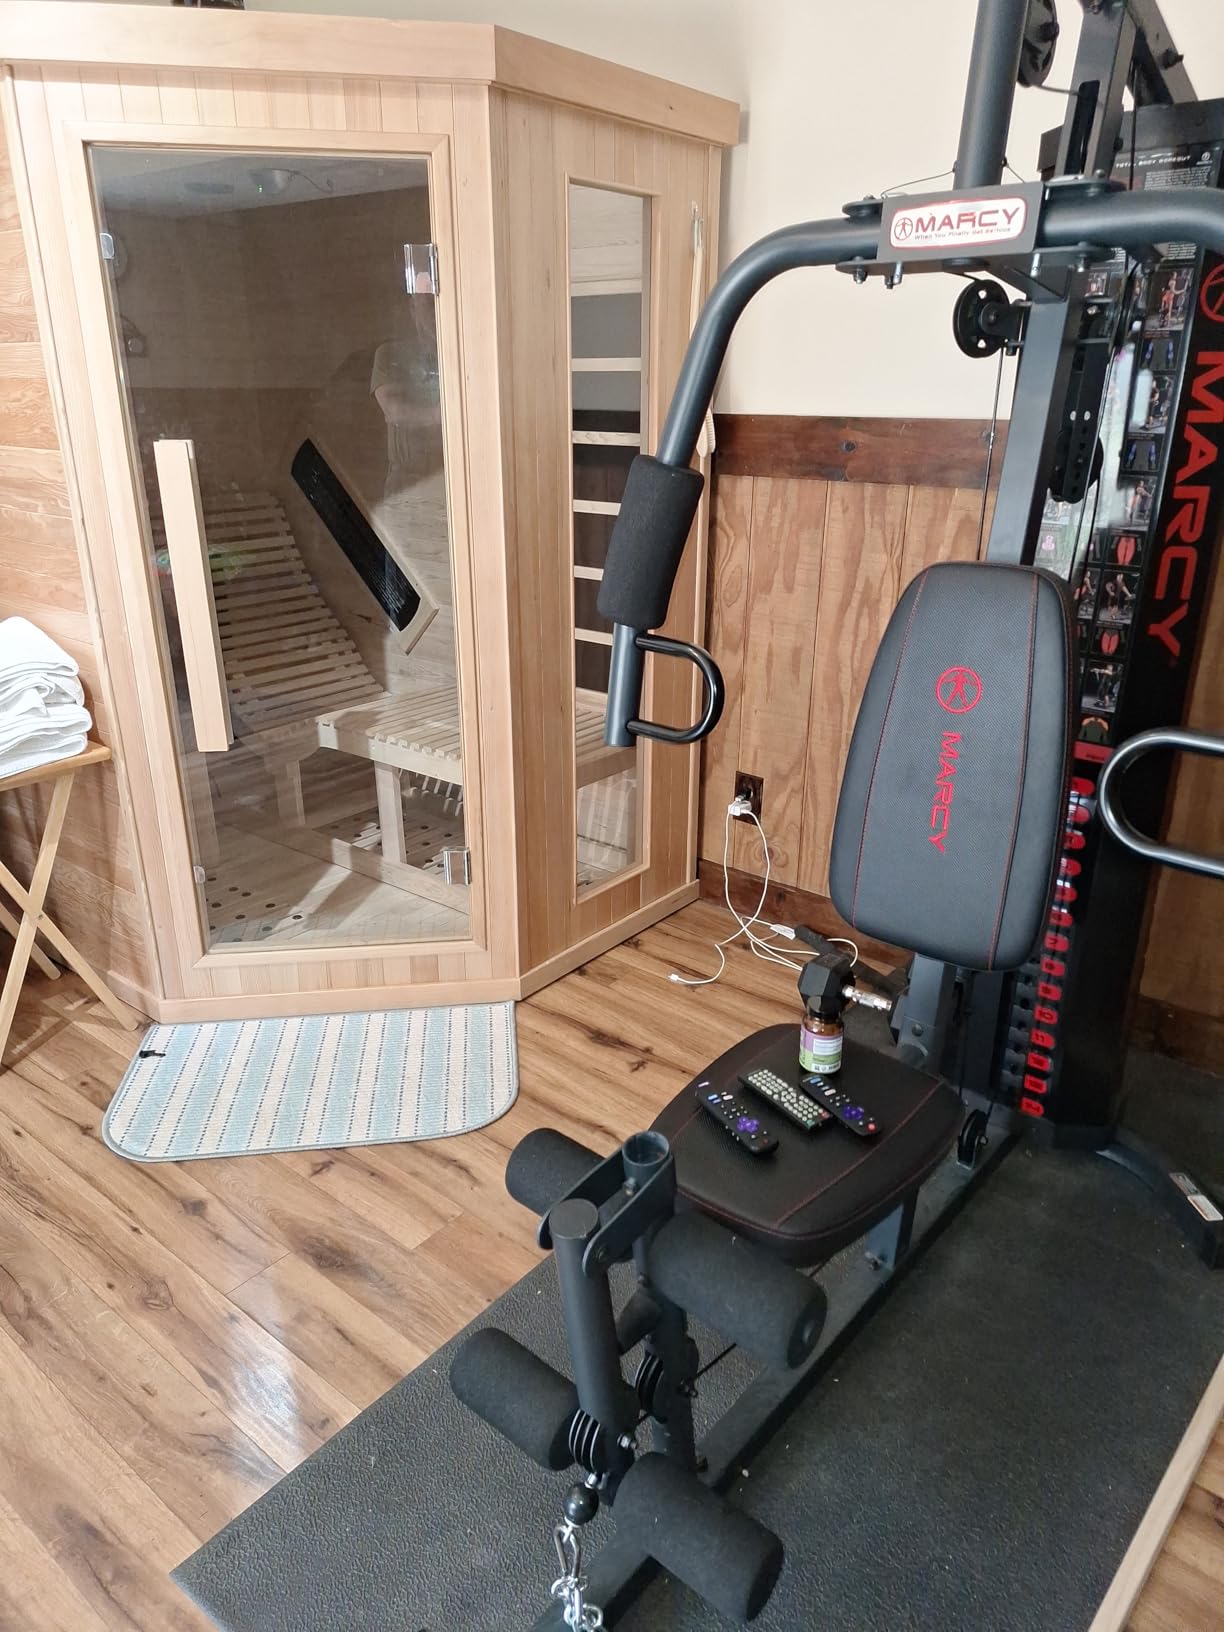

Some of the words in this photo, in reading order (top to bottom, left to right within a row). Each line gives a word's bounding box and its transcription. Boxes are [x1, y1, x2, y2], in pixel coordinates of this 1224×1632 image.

[915, 207, 1020, 233] MARCY
[1147, 352, 1224, 657] MARCY
[928, 731, 962, 853] MARCY
